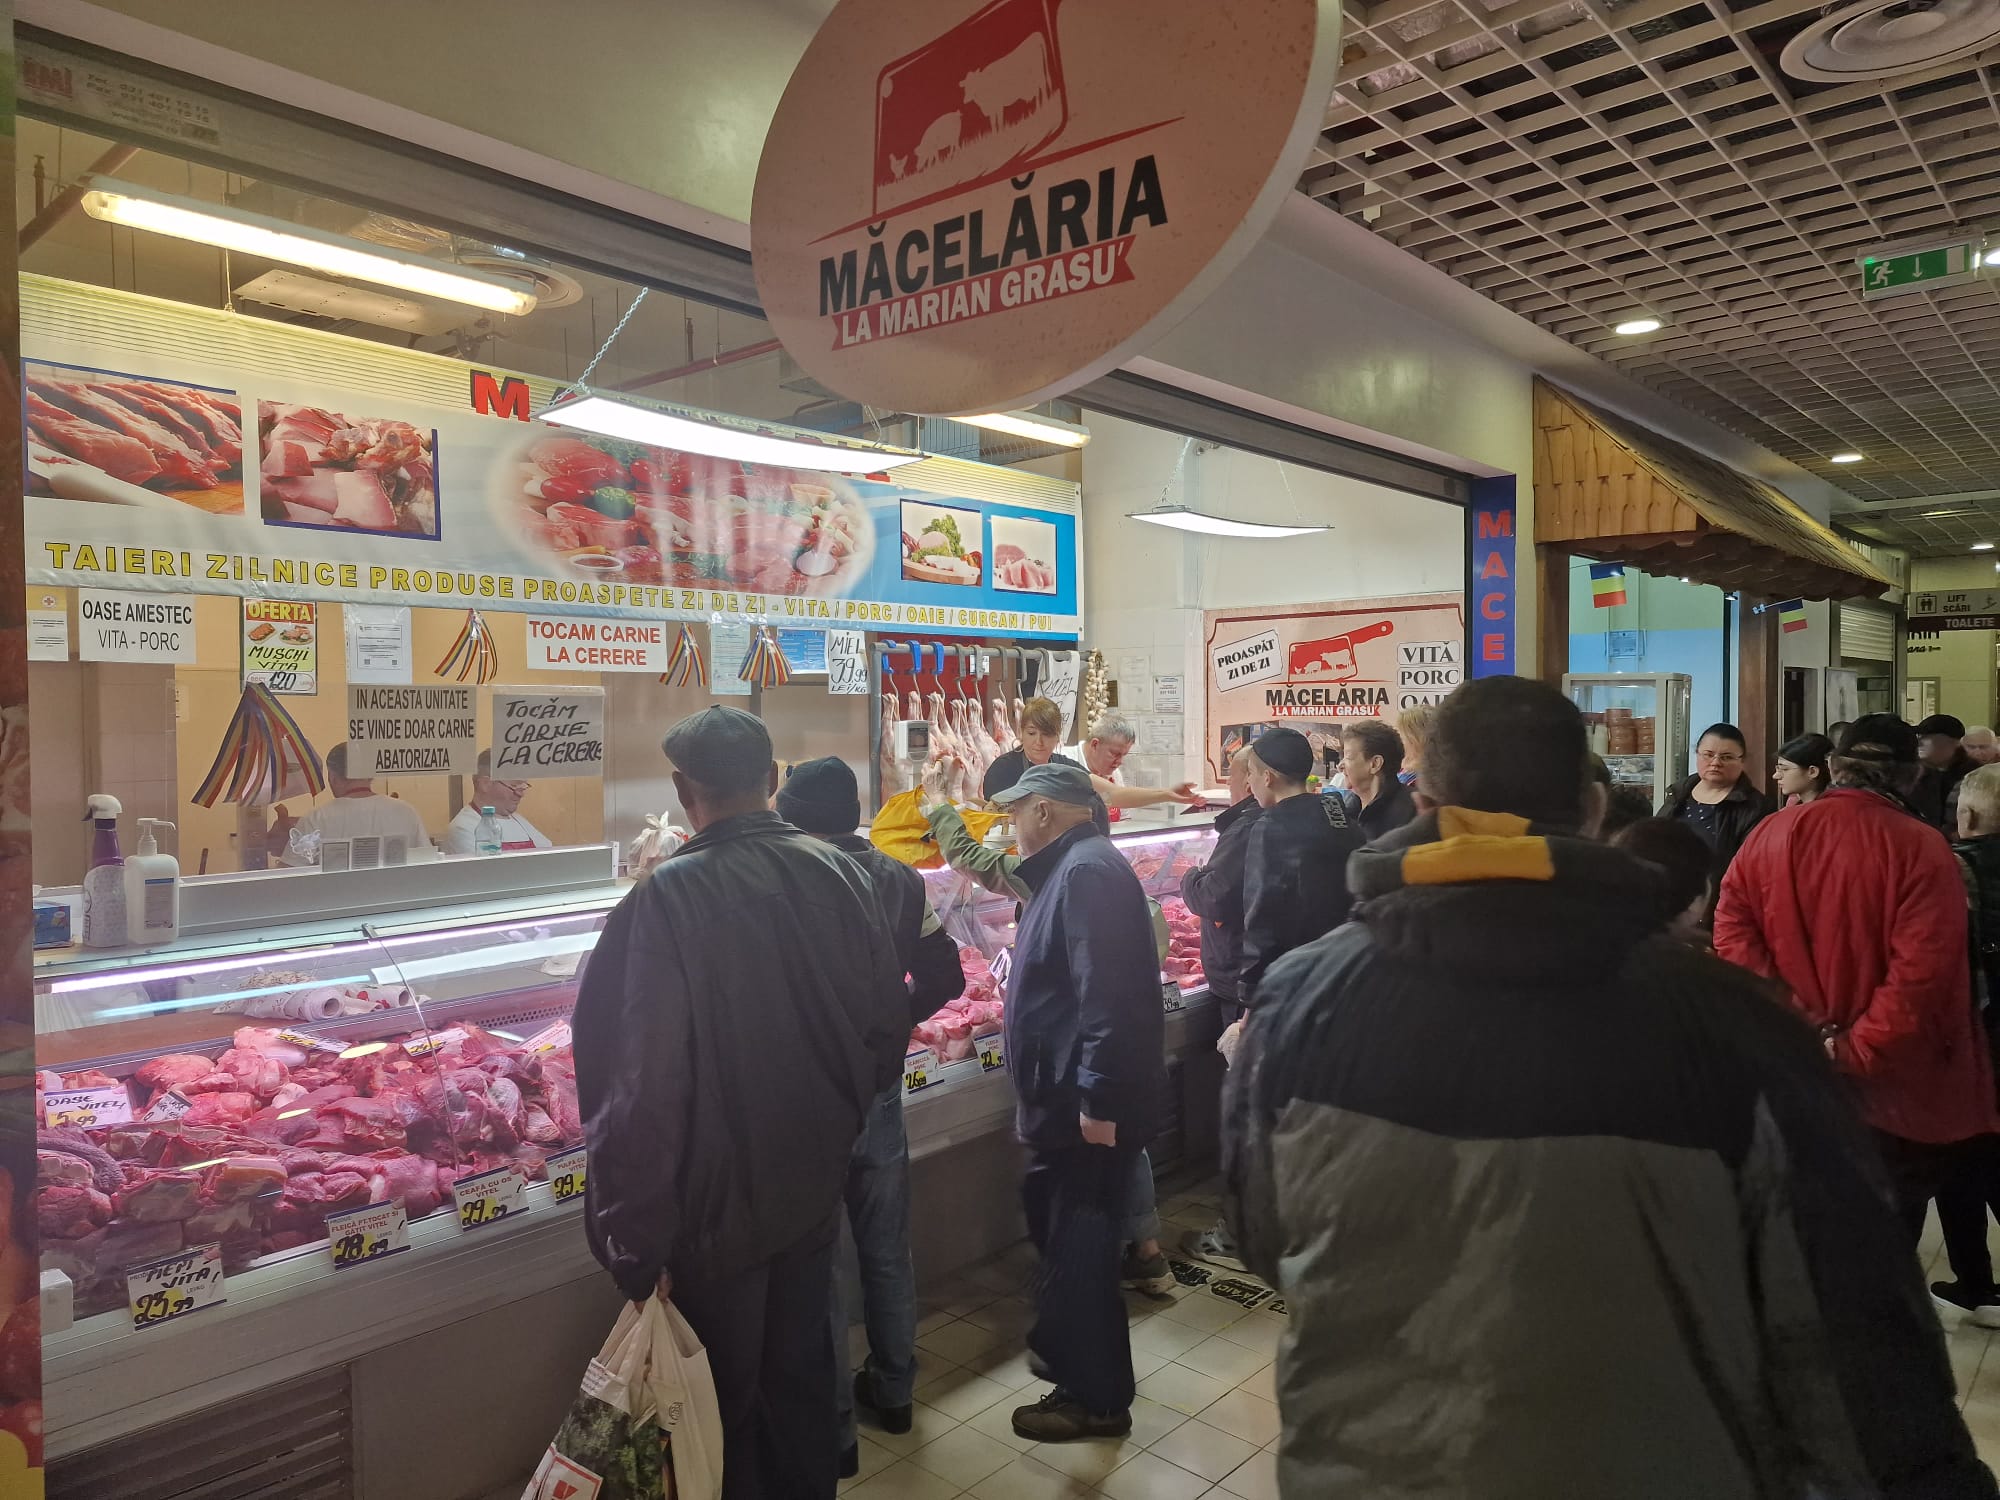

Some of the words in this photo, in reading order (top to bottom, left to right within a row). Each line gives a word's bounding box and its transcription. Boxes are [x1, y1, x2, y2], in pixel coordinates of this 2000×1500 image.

[819, 154, 1169, 317] MĂCELĂRIA
[841, 312, 872, 346] LA
[879, 278, 991, 337] MARIAN
[45, 542, 191, 577] TAIERI
[206, 554, 357, 588] ZILNICE
[369, 566, 514, 598] PRODUSE
[523, 578, 674, 609] PROASPETE
[682, 590, 704, 610] ZI
[712, 592, 739, 613] DE
[745, 595, 766, 614] ZI
[784, 598, 830, 617] VITA
[846, 602, 893, 621] PORC
[906, 606, 945, 625] OAIE
[958, 610, 1018, 630] CURCAN
[1029, 615, 1052, 631] PUI
[1947, 594, 1966, 603] LIFT
[82, 600, 121, 621] OASE
[125, 603, 192, 625] AMESTEC
[248, 602, 312, 622] OFERTA
[1945, 617, 1995, 628] TOALETE
[98, 629, 128, 649] VITA
[140, 631, 180, 651] PORC
[529, 620, 596, 642] TOCAM
[600, 625, 661, 643] CARNE
[546, 646, 570, 663] LA
[575, 647, 647, 666] CERERE
[1217, 638, 1276, 669] PROASPĂT
[1403, 641, 1454, 664] VITĂ
[1227, 668, 1240, 680] ZI
[1241, 662, 1256, 676] DE
[1258, 656, 1271, 669] ZI
[1401, 669, 1459, 686] PORC
[269, 671, 297, 691] 120
[356, 689, 368, 709] IN
[371, 689, 422, 710] ACEASTA
[425, 689, 468, 710] UNITATE
[1265, 682, 1390, 707] MĂCELĂRIA
[1276, 706, 1288, 716] LA
[1291, 706, 1334, 717] MARIAN
[349, 720, 364, 741] SE
[367, 720, 401, 740] VINDE
[404, 720, 434, 740] DOAR
[438, 719, 475, 739] CARNE
[504, 722, 591, 744] CARNE
[375, 748, 450, 769] ABATORIZATA
[497, 745, 531, 768] LA
[535, 740, 603, 766] CERERE
[46, 1095, 92, 1107] OASE
[488, 1180, 500, 1188] CU
[501, 1176, 513, 1184] OS
